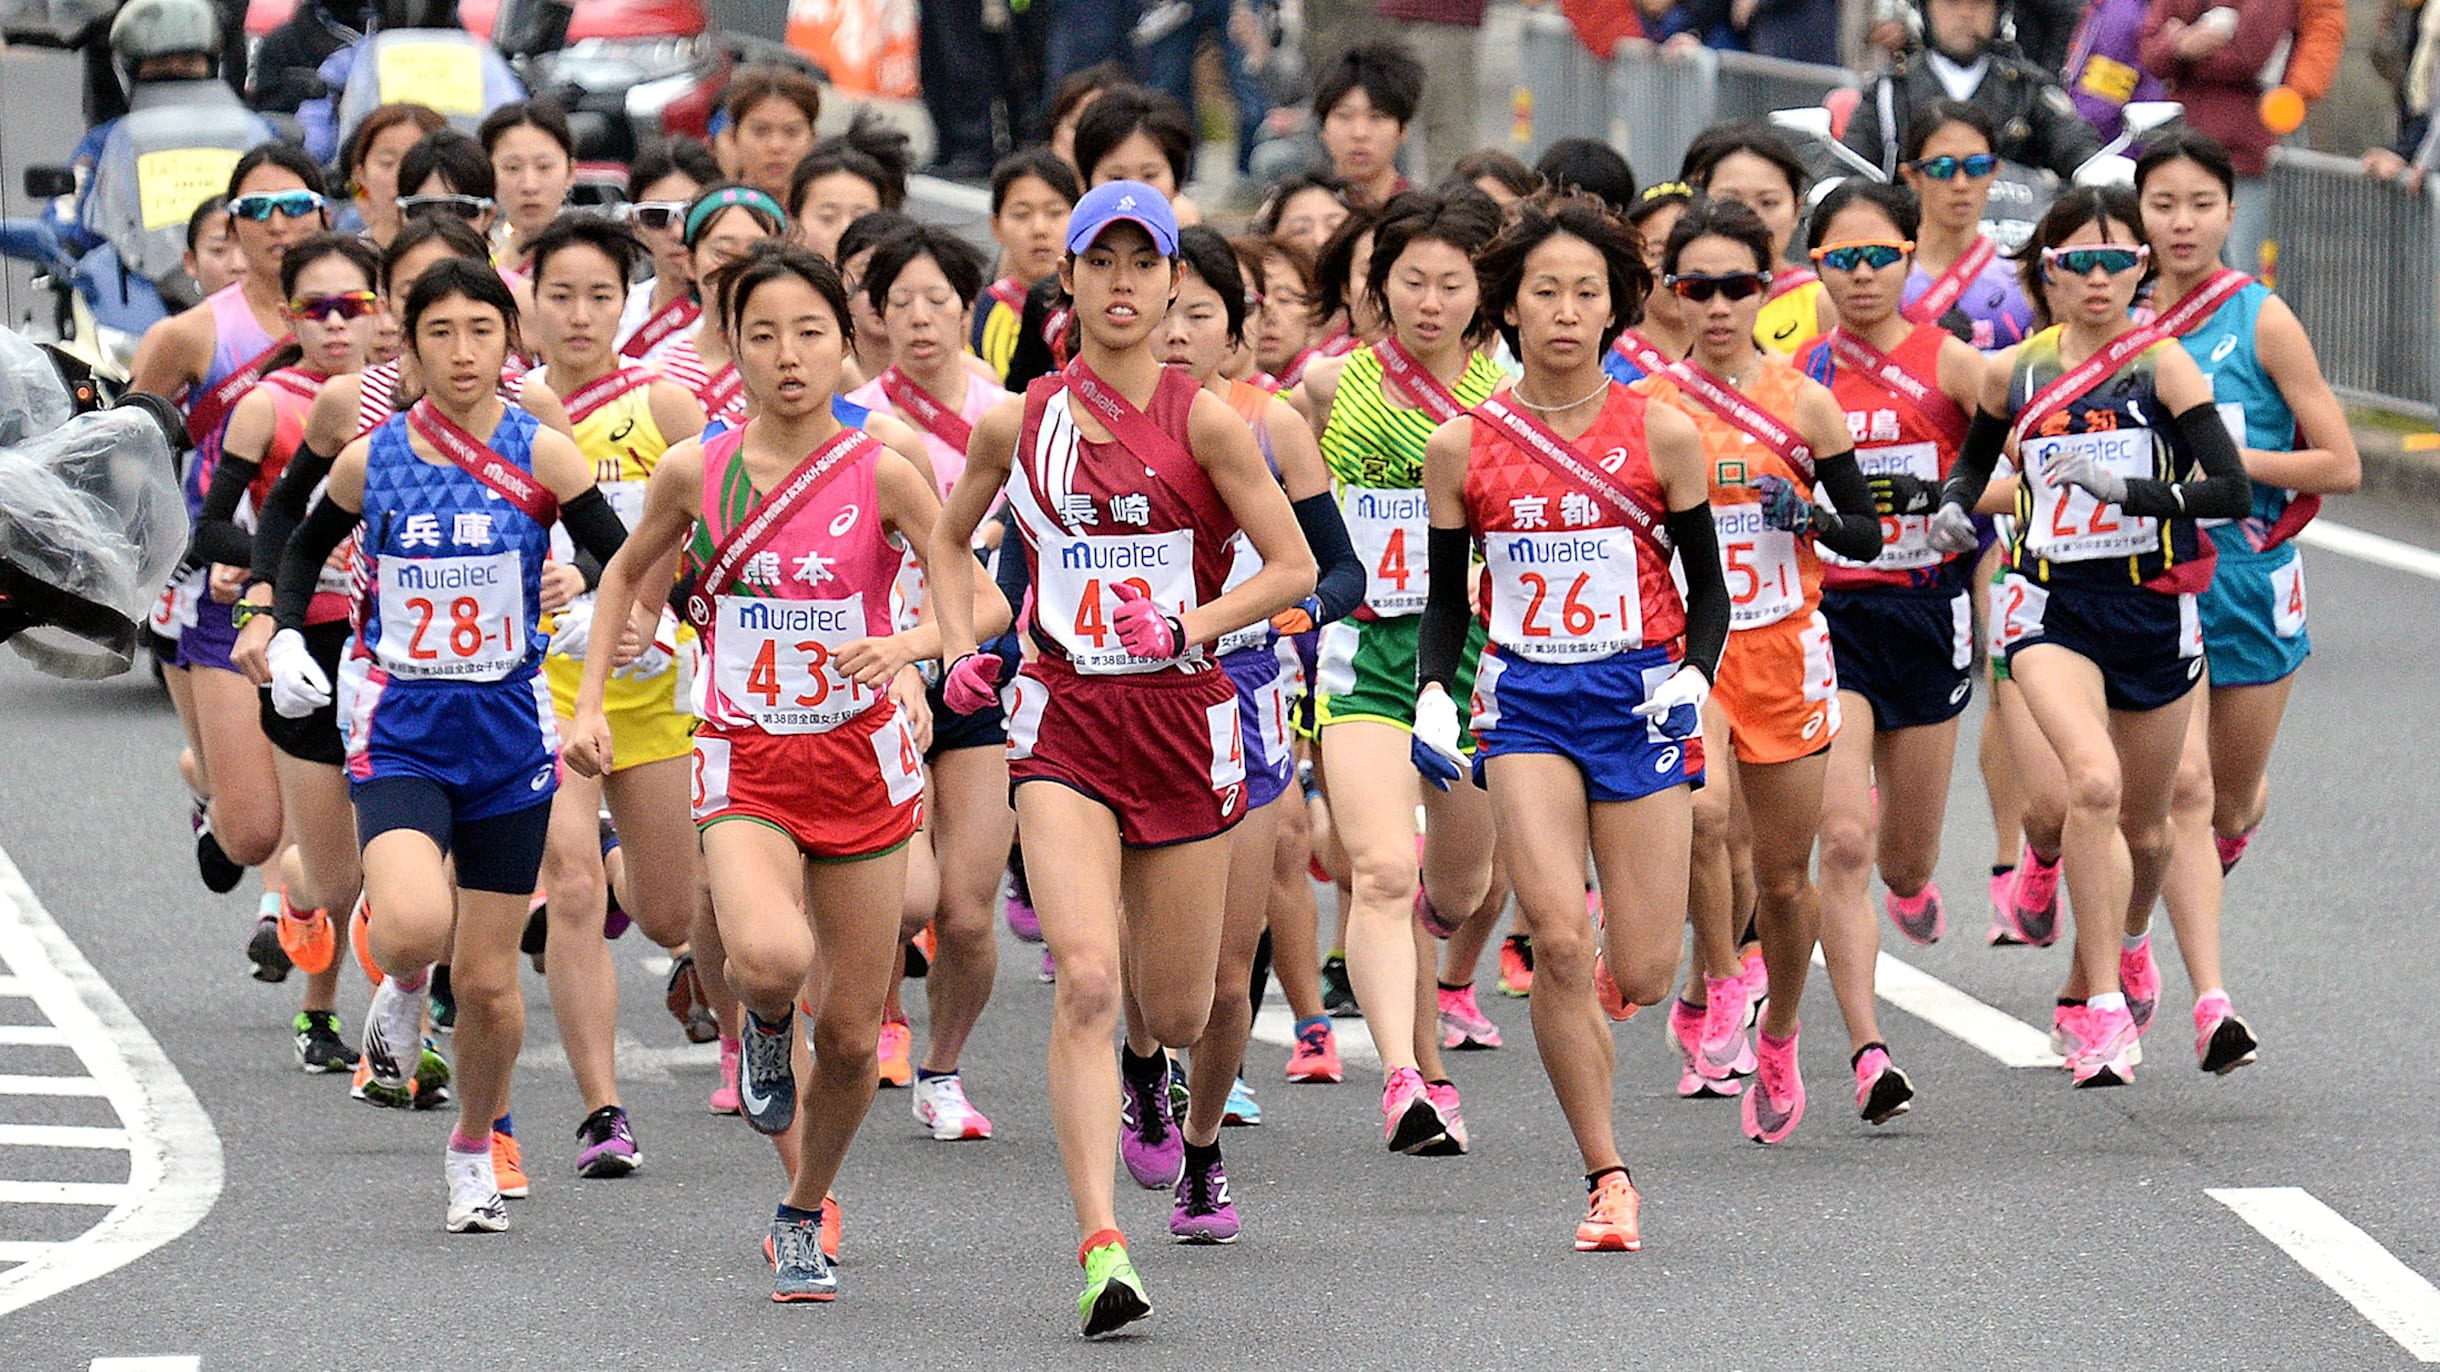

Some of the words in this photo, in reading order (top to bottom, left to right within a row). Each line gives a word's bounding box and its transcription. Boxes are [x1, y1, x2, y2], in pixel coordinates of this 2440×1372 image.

[481, 461, 533, 500] muratec
[1060, 493, 1151, 527] 長崎
[1509, 492, 1600, 528] 京都
[399, 512, 492, 549] 兵庫
[1062, 541, 1169, 569] muratec
[1508, 538, 1610, 563] muratec
[397, 563, 499, 589] muratec
[742, 551, 836, 587] 熊本
[740, 603, 847, 632] muratec
[1519, 571, 1629, 637] 26-1
[405, 596, 513, 660] 28-1
